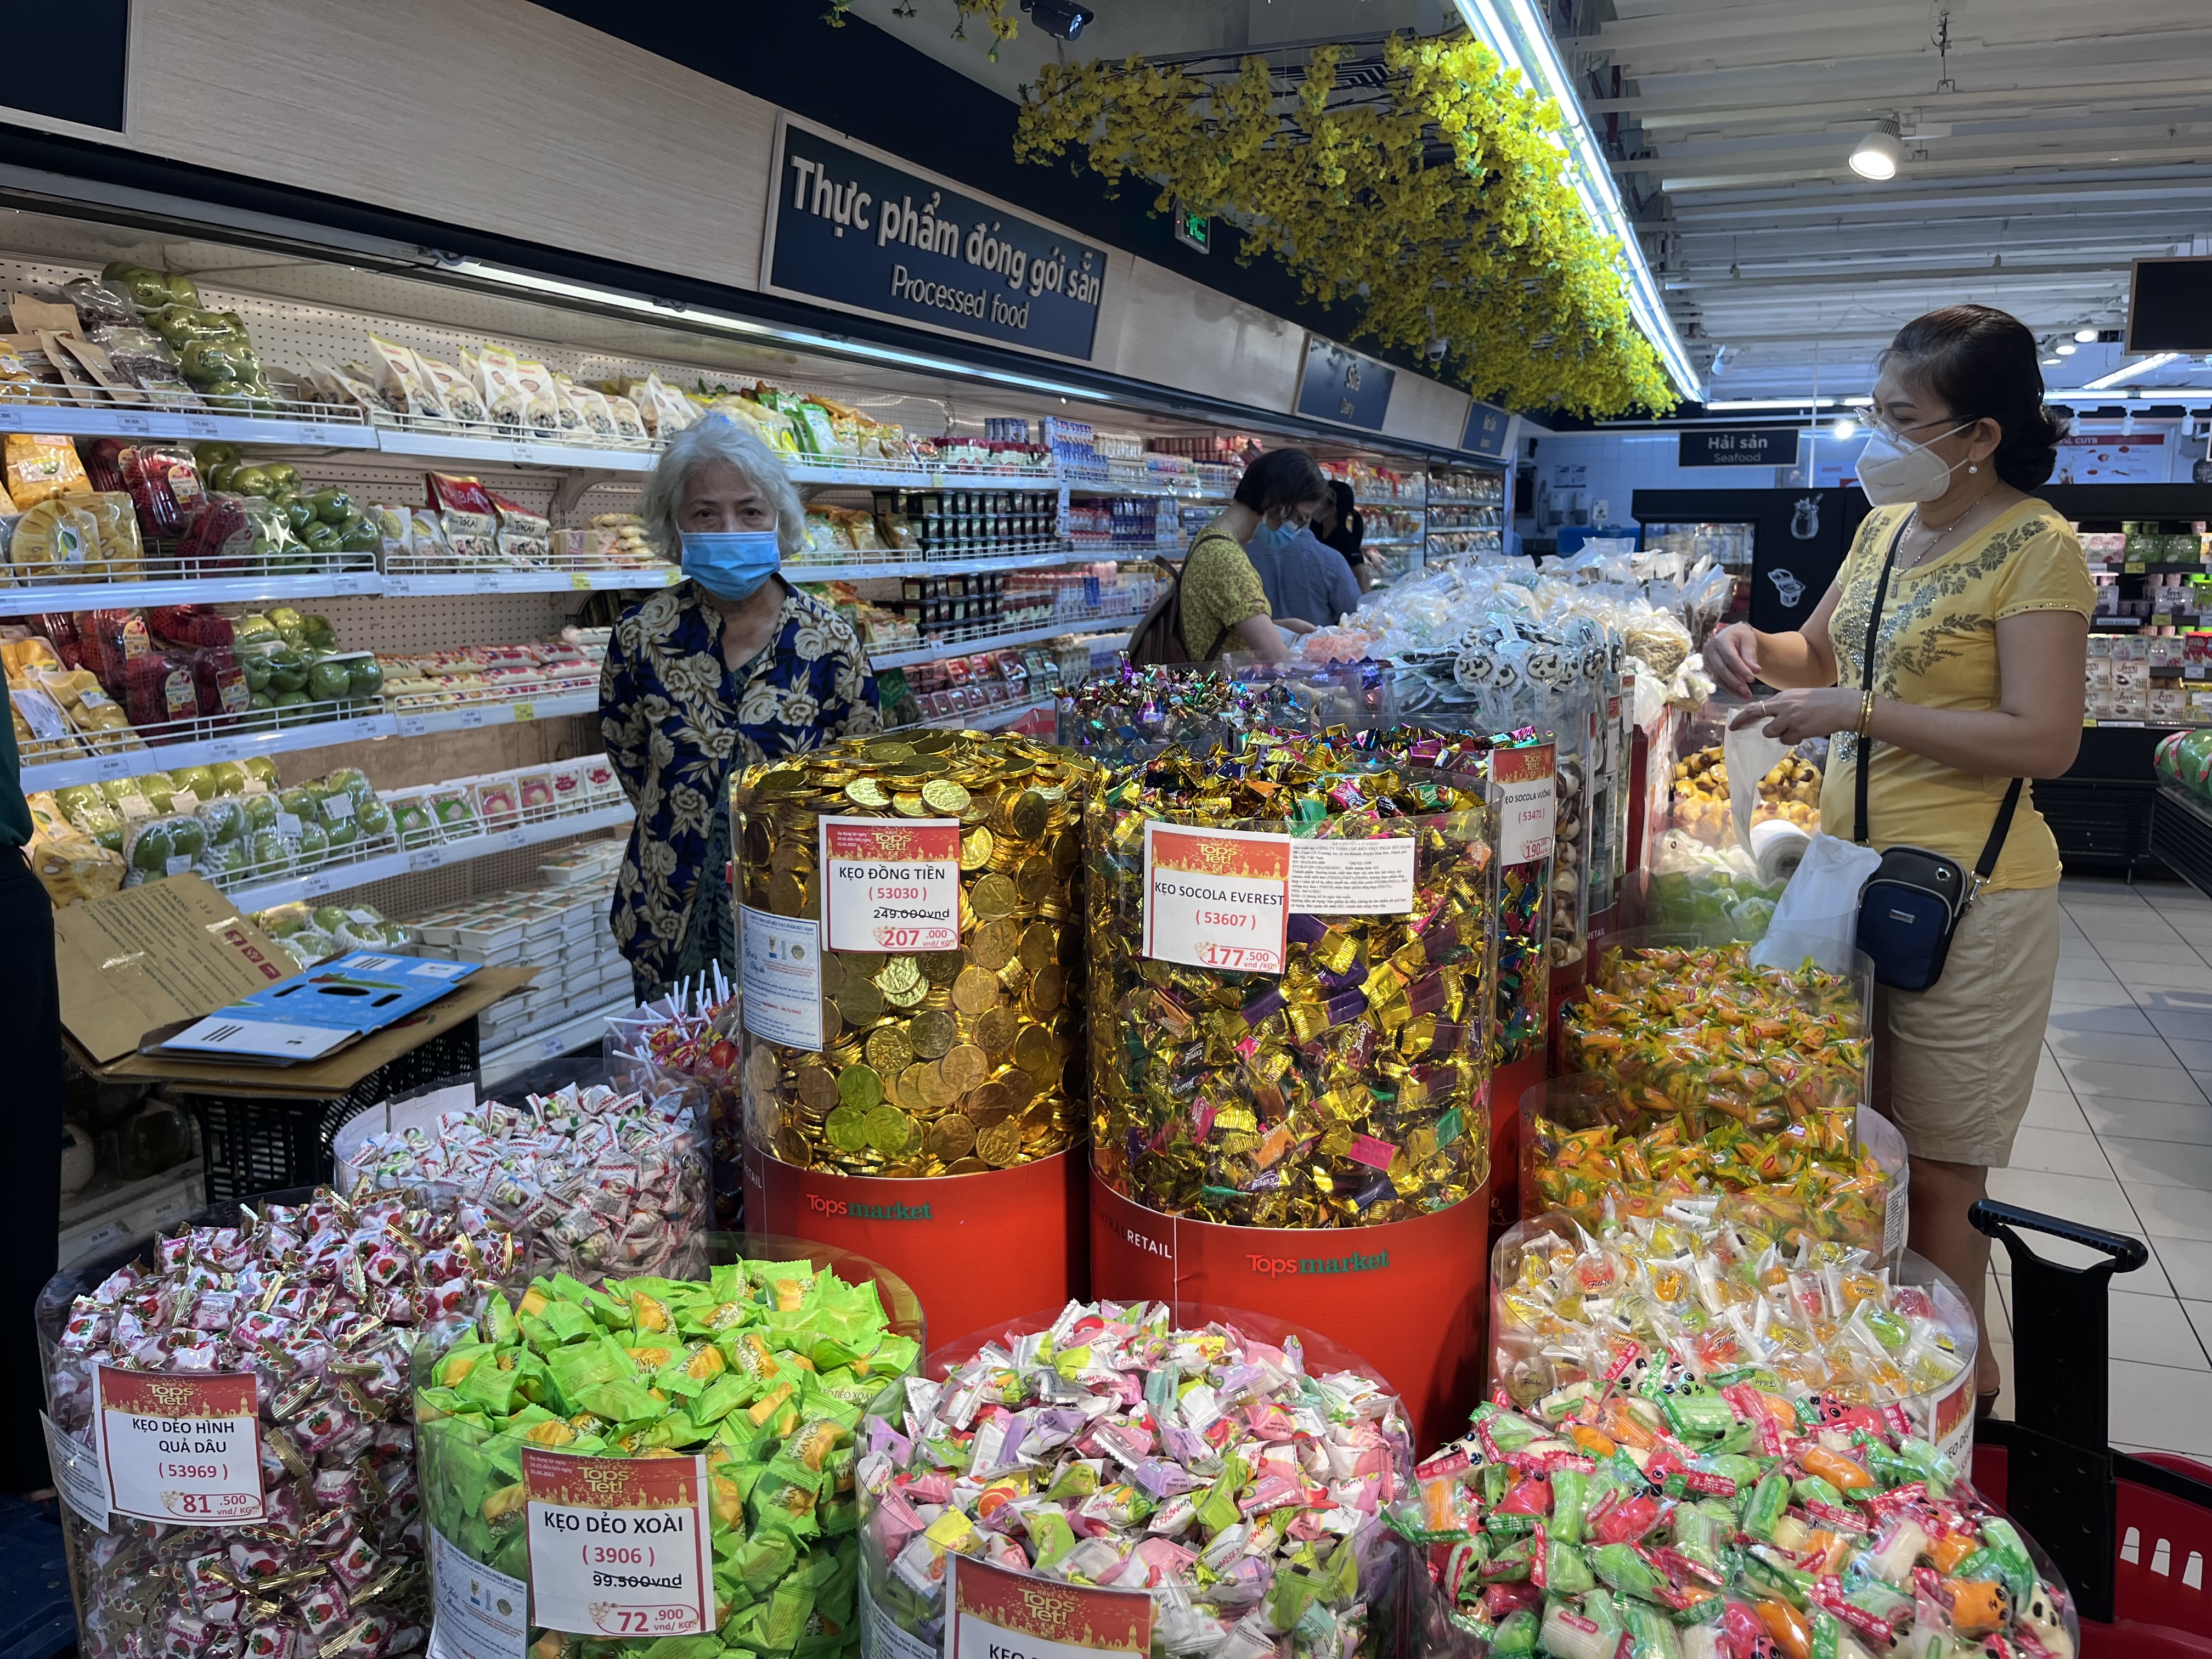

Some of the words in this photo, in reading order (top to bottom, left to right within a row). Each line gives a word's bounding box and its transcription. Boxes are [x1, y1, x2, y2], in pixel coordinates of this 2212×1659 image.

[791, 155, 872, 238] Thực
[877, 191, 959, 258] phẩm
[965, 221, 1026, 289] đóng
[1028, 246, 1066, 296] gói
[1066, 251, 1099, 305] sẵn
[891, 264, 986, 319] Processed
[990, 293, 1030, 330] food
[1713, 452, 1761, 463] Seafood
[1523, 754, 1542, 764] Tops
[1515, 792, 1536, 803] SOCOLA
[871, 832, 912, 843] Tops
[877, 842, 906, 851] Tet!
[1197, 843, 1238, 856] Tops
[1202, 853, 1232, 865] Tet!
[839, 867, 864, 881] KẸO
[868, 864, 910, 879] ĐỒNG
[914, 865, 945, 879] TIỀN
[1155, 882, 1176, 895] KẸO
[1179, 886, 1227, 901] SOCOLA
[1231, 891, 1285, 905] EVEREST
[873, 908, 950, 920] 249.000vnd
[884, 930, 920, 946] 207
[926, 930, 947, 939] .000
[1207, 947, 1244, 966] 177
[1245, 952, 1269, 962] .500
[146, 1383, 194, 1397] Tops
[154, 1393, 189, 1406] Tet!
[132, 1418, 158, 1433] KẸO
[162, 1417, 191, 1434] DẺO
[196, 1419, 235, 1434] HÌNH
[159, 1438, 191, 1453] QUẢ
[194, 1438, 227, 1453] DÂU
[577, 1466, 630, 1482] Tops
[585, 1479, 623, 1494] Tet!
[183, 1494, 211, 1514] 81
[219, 1495, 247, 1506] .500
[544, 1511, 580, 1533] KẸO
[587, 1511, 627, 1533] DẺO
[633, 1513, 684, 1534] XOÀI
[594, 1547, 642, 1564] 3906
[592, 1573, 682, 1588] 99.500vnd
[1018, 1588, 1075, 1613] Tops
[617, 1611, 649, 1632] 72
[654, 1609, 684, 1621] .900
[1026, 1603, 1066, 1626] Tet!
